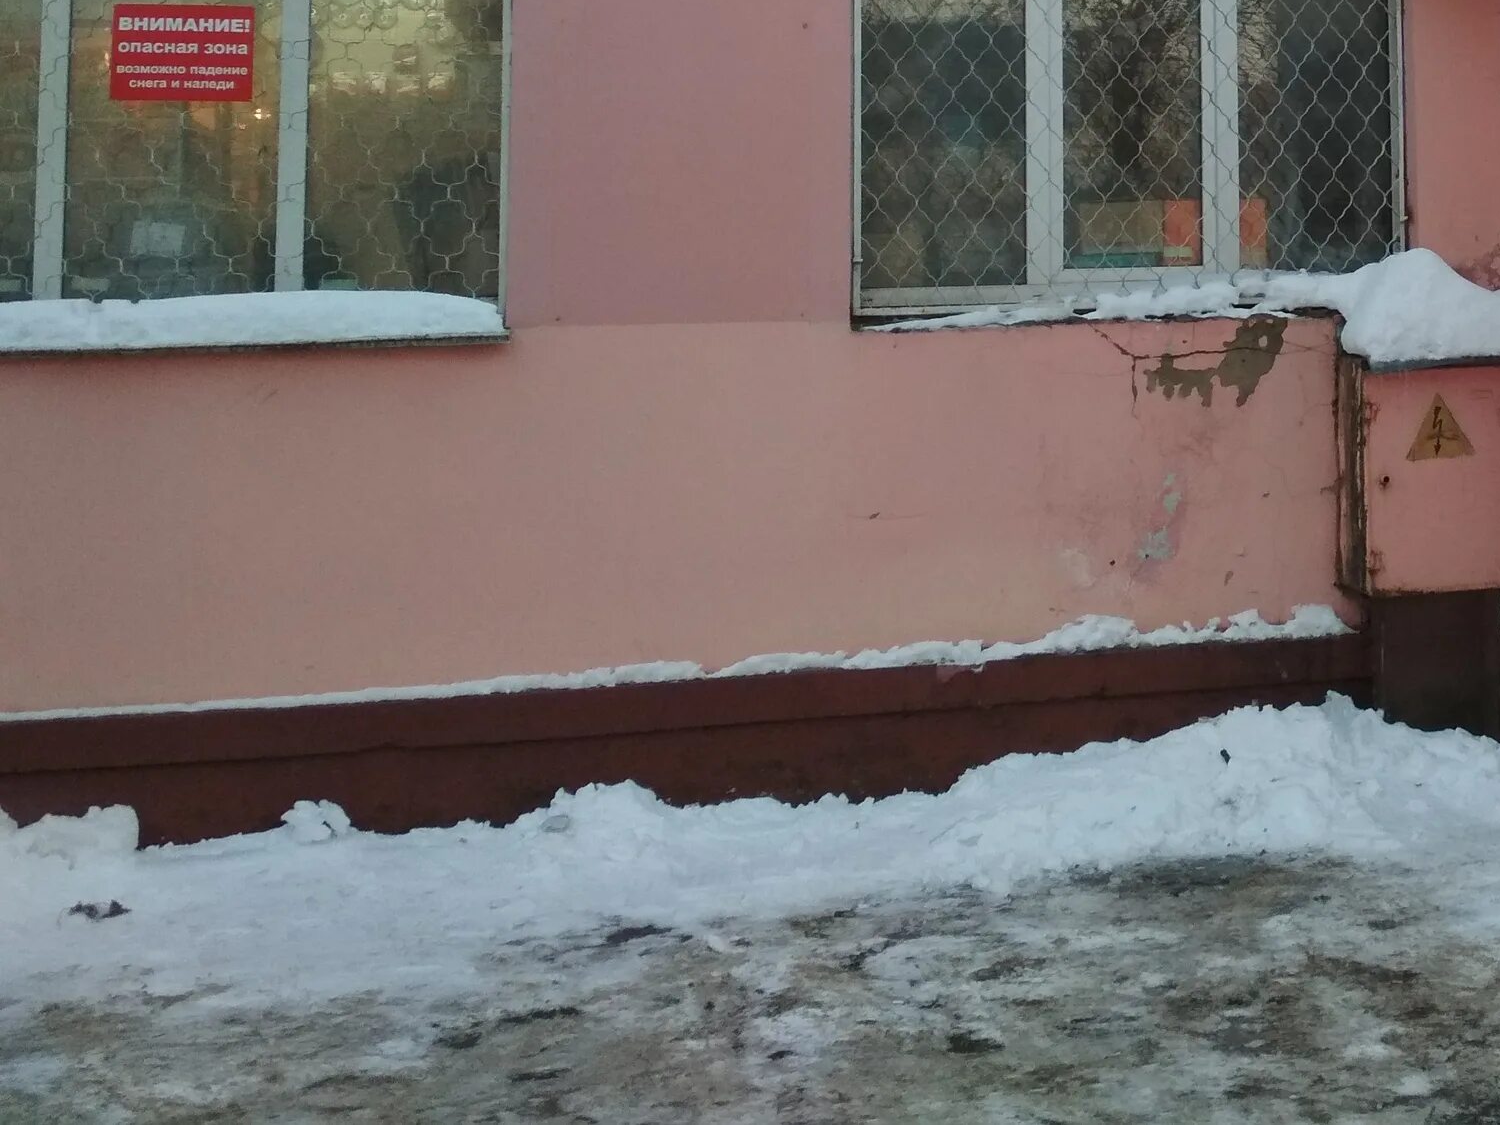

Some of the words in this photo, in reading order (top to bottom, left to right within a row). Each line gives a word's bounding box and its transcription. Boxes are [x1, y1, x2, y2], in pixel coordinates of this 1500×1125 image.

[118, 16, 250, 33] ВНИМАНИЕ!
[118, 41, 198, 54] опасная
[204, 43, 248, 55] зона
[116, 65, 186, 74] возможно
[190, 66, 248, 76] падение
[129, 79, 167, 89] снега
[171, 80, 180, 89] и
[184, 80, 235, 91] наледи
